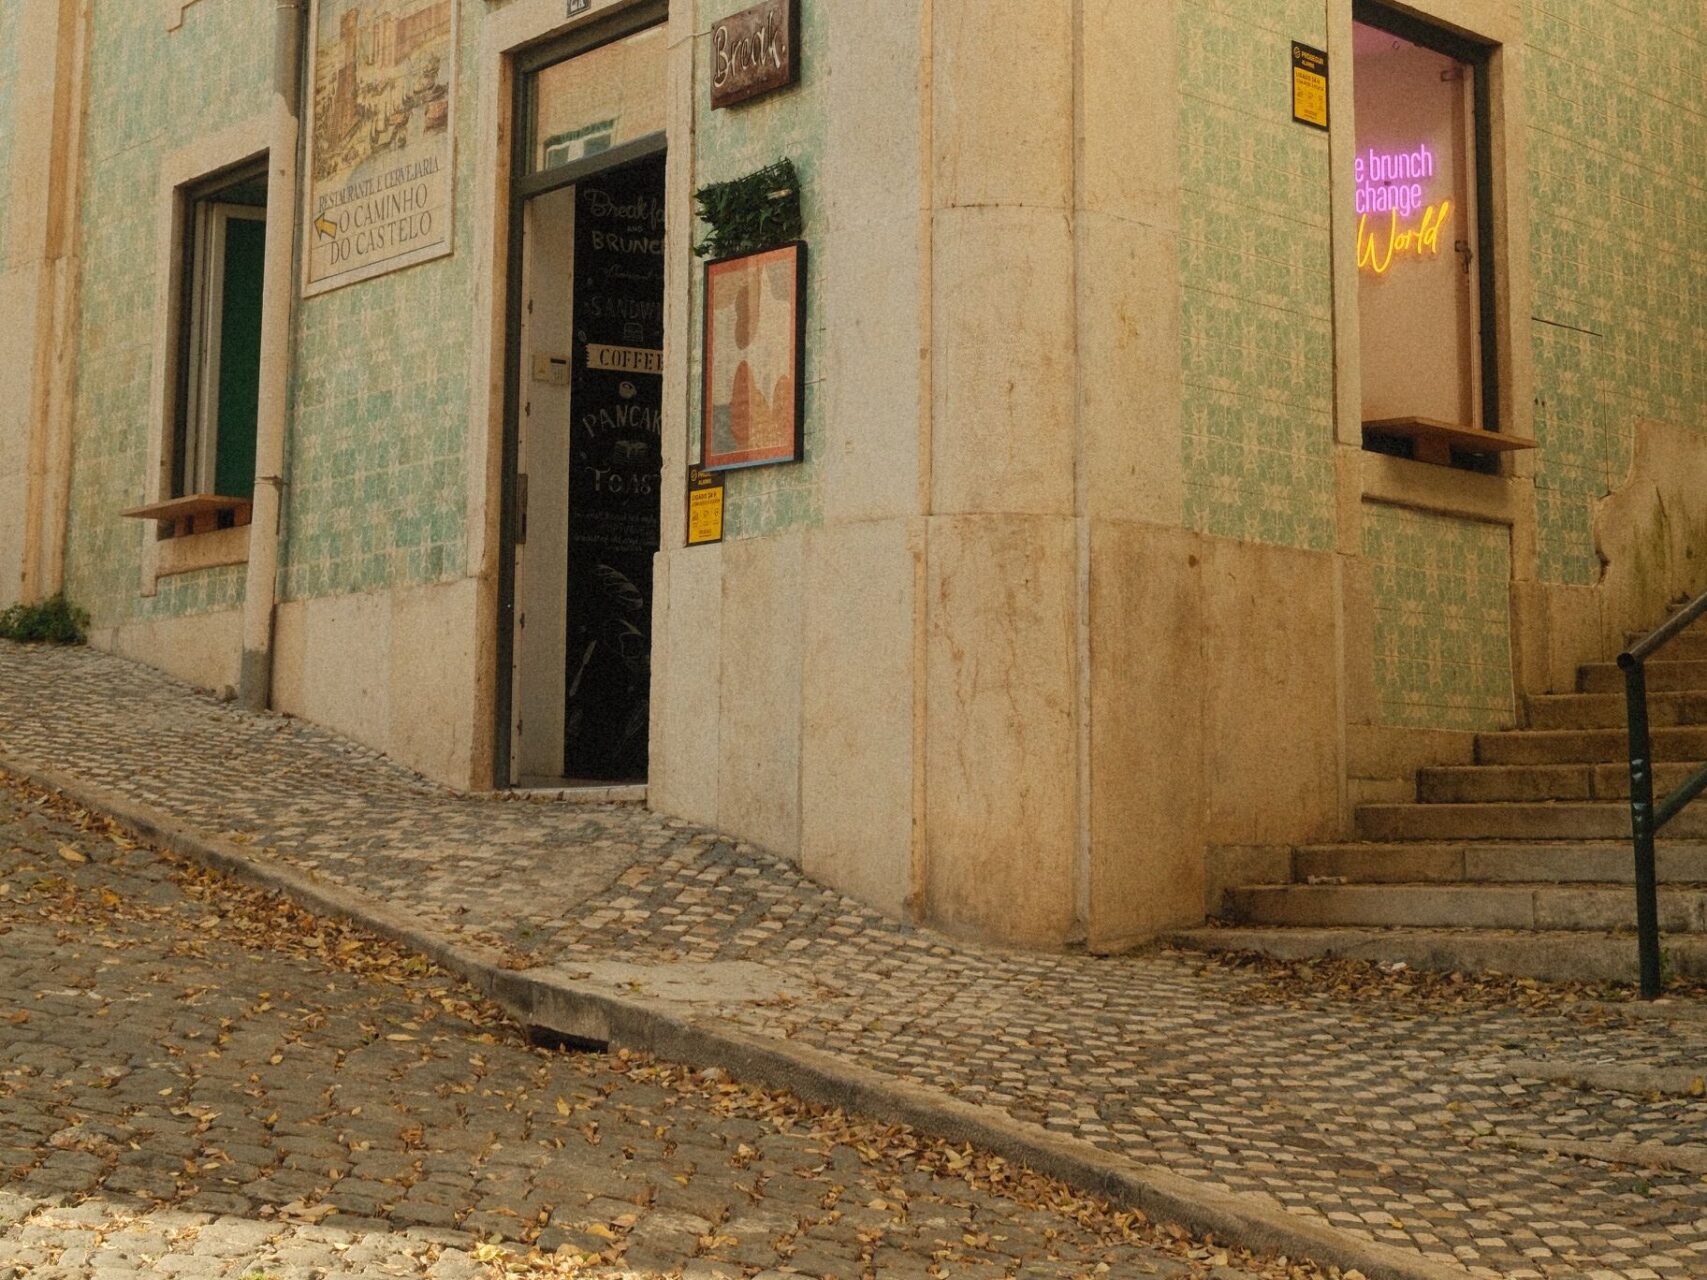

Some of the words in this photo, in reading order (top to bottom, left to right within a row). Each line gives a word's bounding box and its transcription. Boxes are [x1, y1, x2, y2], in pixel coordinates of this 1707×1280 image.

[318, 176, 376, 212] RESTAURANTE
[377, 175, 384, 192] E
[385, 156, 440, 188] CERVEJARIA
[1369, 143, 1433, 181] brunch
[338, 210, 350, 233] O
[353, 182, 428, 228] CAMINHO
[1355, 179, 1422, 217] change
[330, 238, 351, 266] DO
[356, 210, 432, 255] CASTELO
[1357, 201, 1449, 273] World
